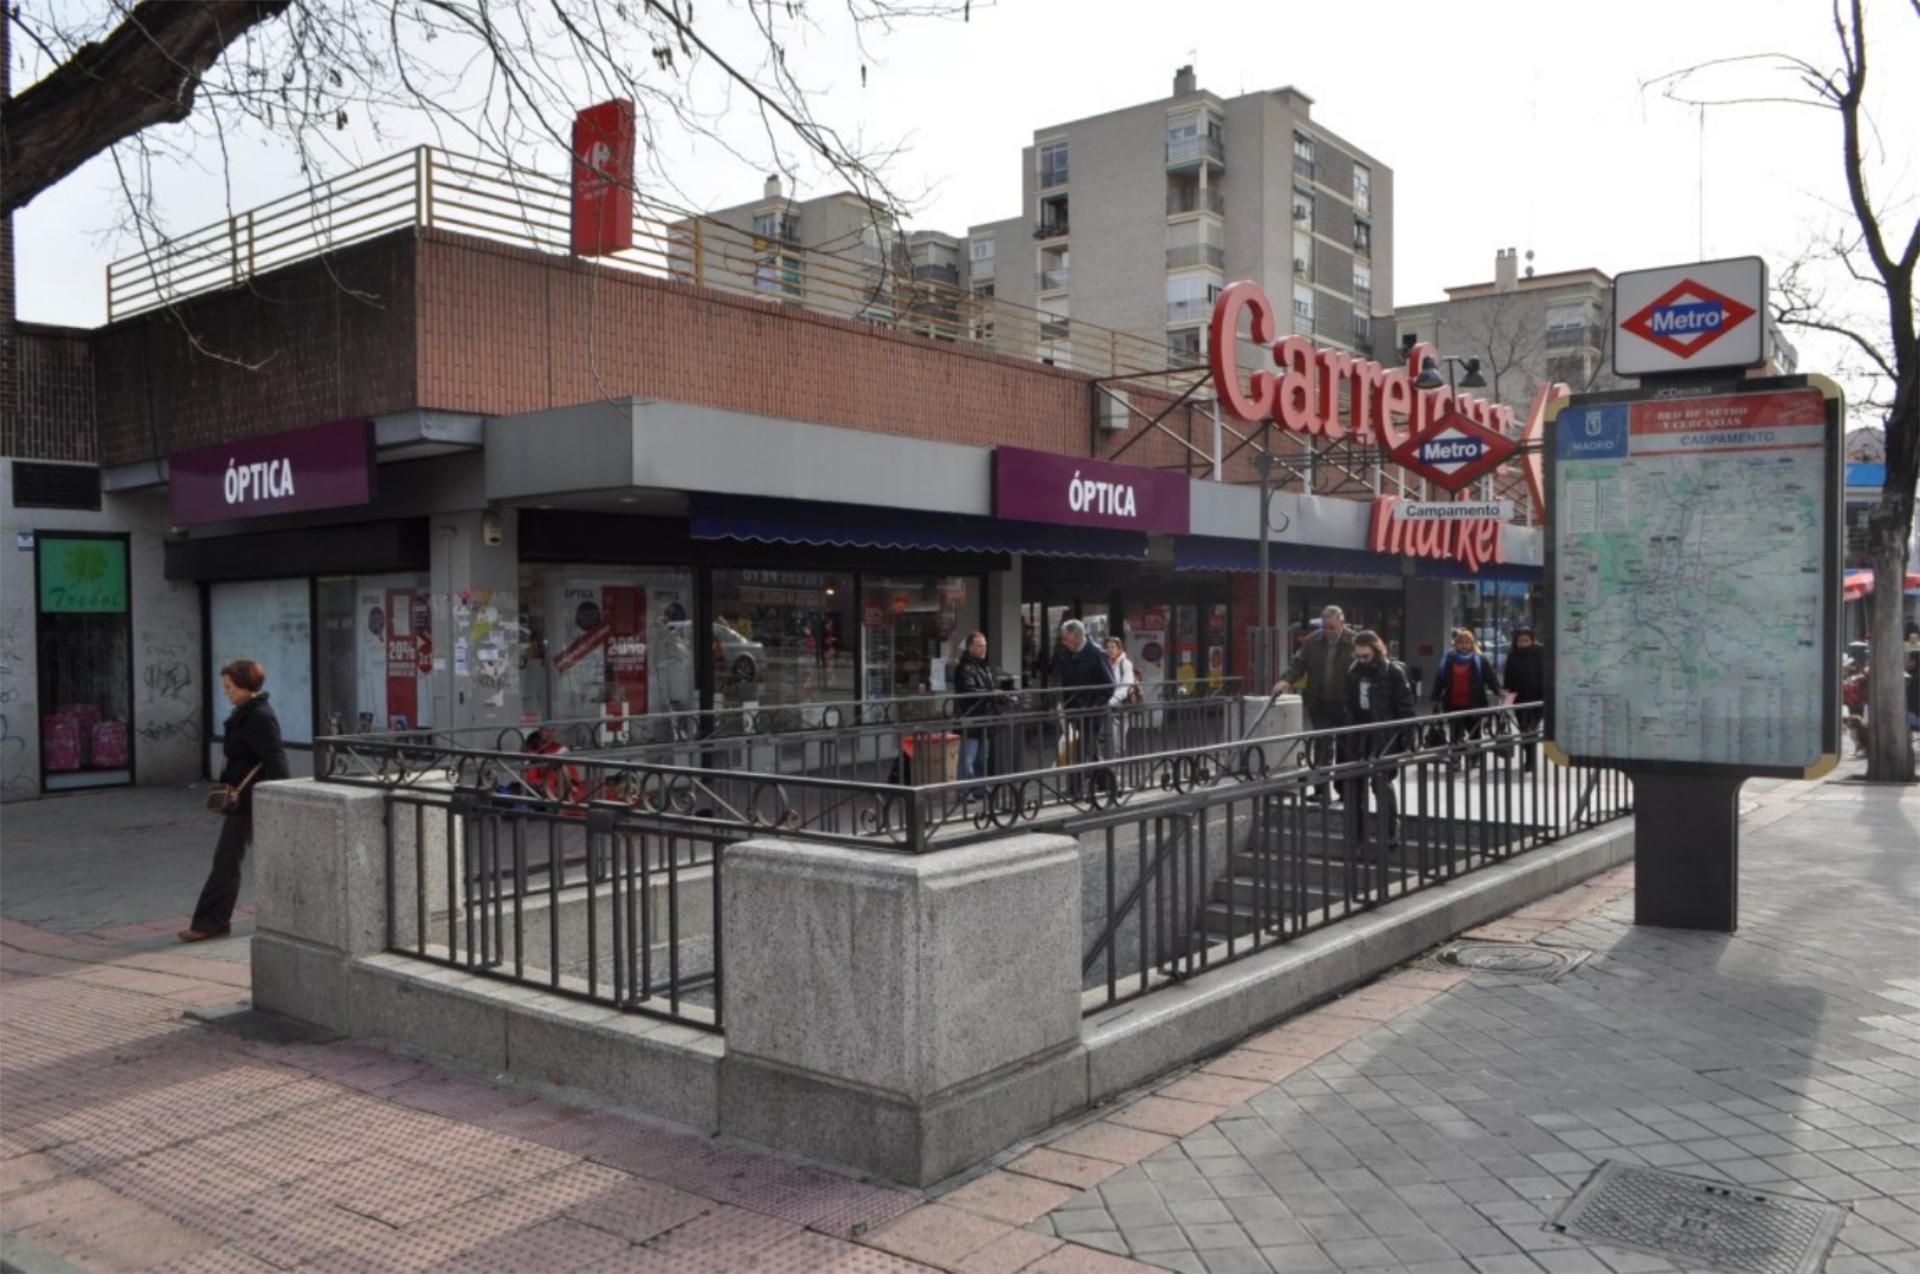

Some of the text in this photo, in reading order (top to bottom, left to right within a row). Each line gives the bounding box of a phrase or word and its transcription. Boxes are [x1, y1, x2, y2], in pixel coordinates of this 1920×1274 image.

[1653, 310, 1719, 332] Metro
[1704, 406, 1748, 417] METRO
[1572, 439, 1615, 450] MADRID
[1680, 430, 1775, 447] CAMPAMENTO
[1424, 442, 1478, 460] Metro
[224, 457, 295, 504] ÓPTICA
[1068, 469, 1137, 517] ÓPTICA
[1405, 504, 1501, 519] Campamento
